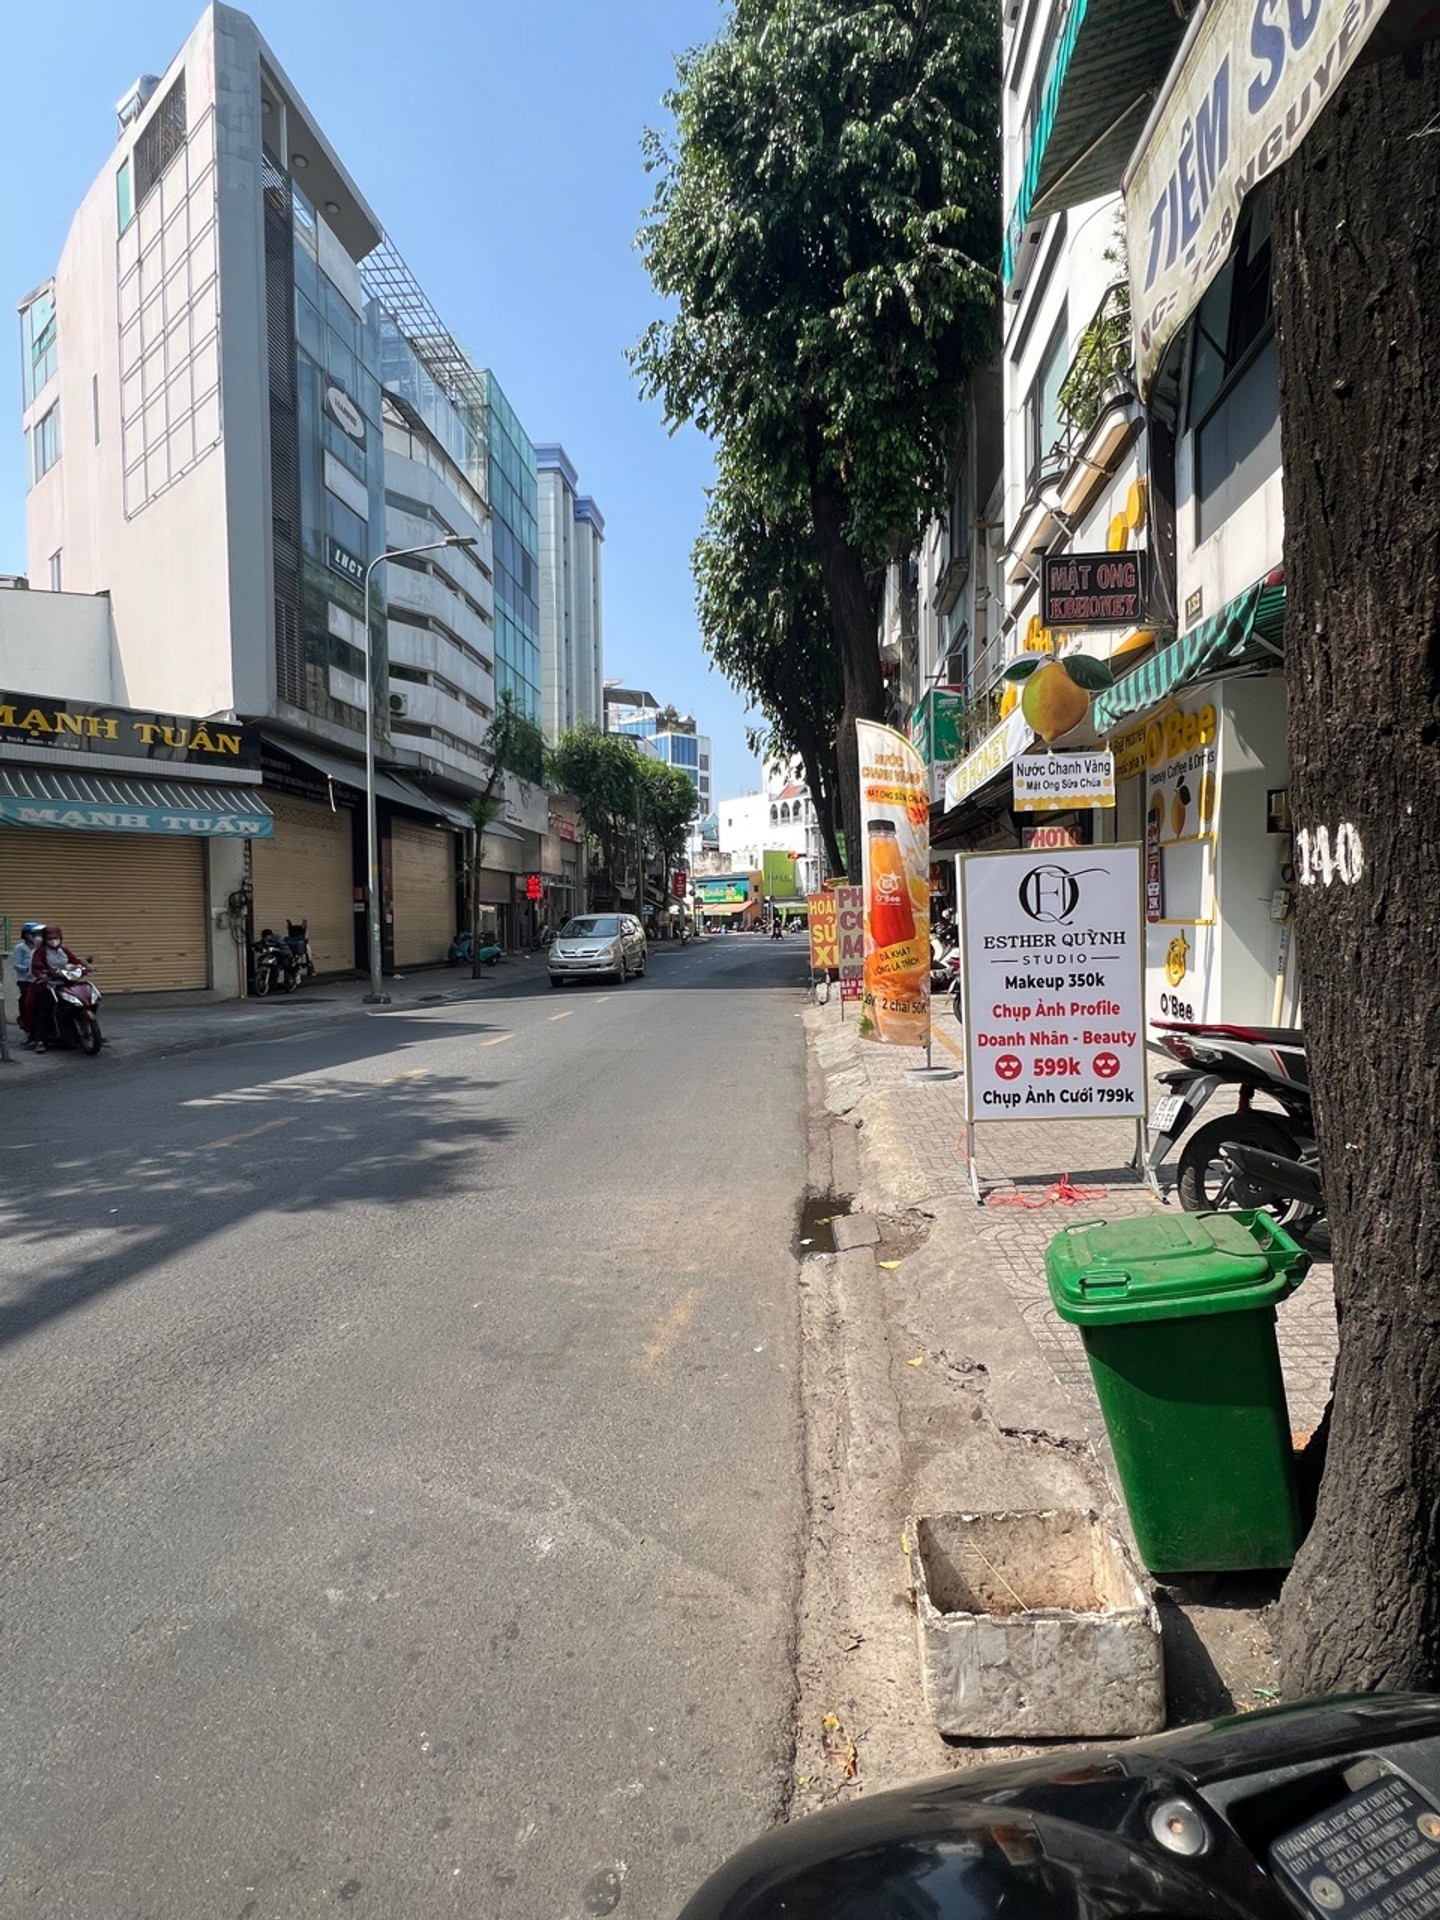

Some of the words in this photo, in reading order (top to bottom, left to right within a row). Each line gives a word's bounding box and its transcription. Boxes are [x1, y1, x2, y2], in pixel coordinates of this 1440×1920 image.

[1144, 51, 1230, 292] TIỆM
[1051, 560, 1091, 595] MẬT
[1097, 563, 1136, 589] ONG
[133, 721, 241, 754] TUẤN
[1017, 762, 1045, 777] Nước
[1048, 761, 1081, 775] Chanh
[1084, 759, 1111, 776] Vàng
[1042, 780, 1060, 791] Ong
[1061, 778, 1078, 789] Sữa
[17, 807, 149, 829] MẠNH
[162, 815, 263, 834] TUẤN
[1024, 828, 1082, 848] PHOTO
[983, 934, 1056, 949] ESTHER
[1061, 929, 1126, 947] QUỲNH
[1022, 953, 1087, 966] STUDIO
[1005, 974, 1064, 991] Makeup
[1068, 972, 1106, 988] 350k
[890, 1000, 910, 1013] chai
[992, 1004, 1032, 1022] Chụp
[1035, 998, 1065, 1017] Ảnh
[1070, 1000, 1121, 1016] Profile
[1161, 993, 1193, 1020] O'Bee
[977, 1032, 1025, 1047] Doanh
[1030, 1031, 1069, 1045] Nhân
[1083, 1030, 1137, 1047] Beauty
[1033, 1057, 1081, 1077] 599k
[982, 1090, 1021, 1108] Chụp
[1025, 1085, 1055, 1104] Ảnh
[1060, 1087, 1093, 1103] Cưới
[1097, 1087, 1134, 1102] 799k
